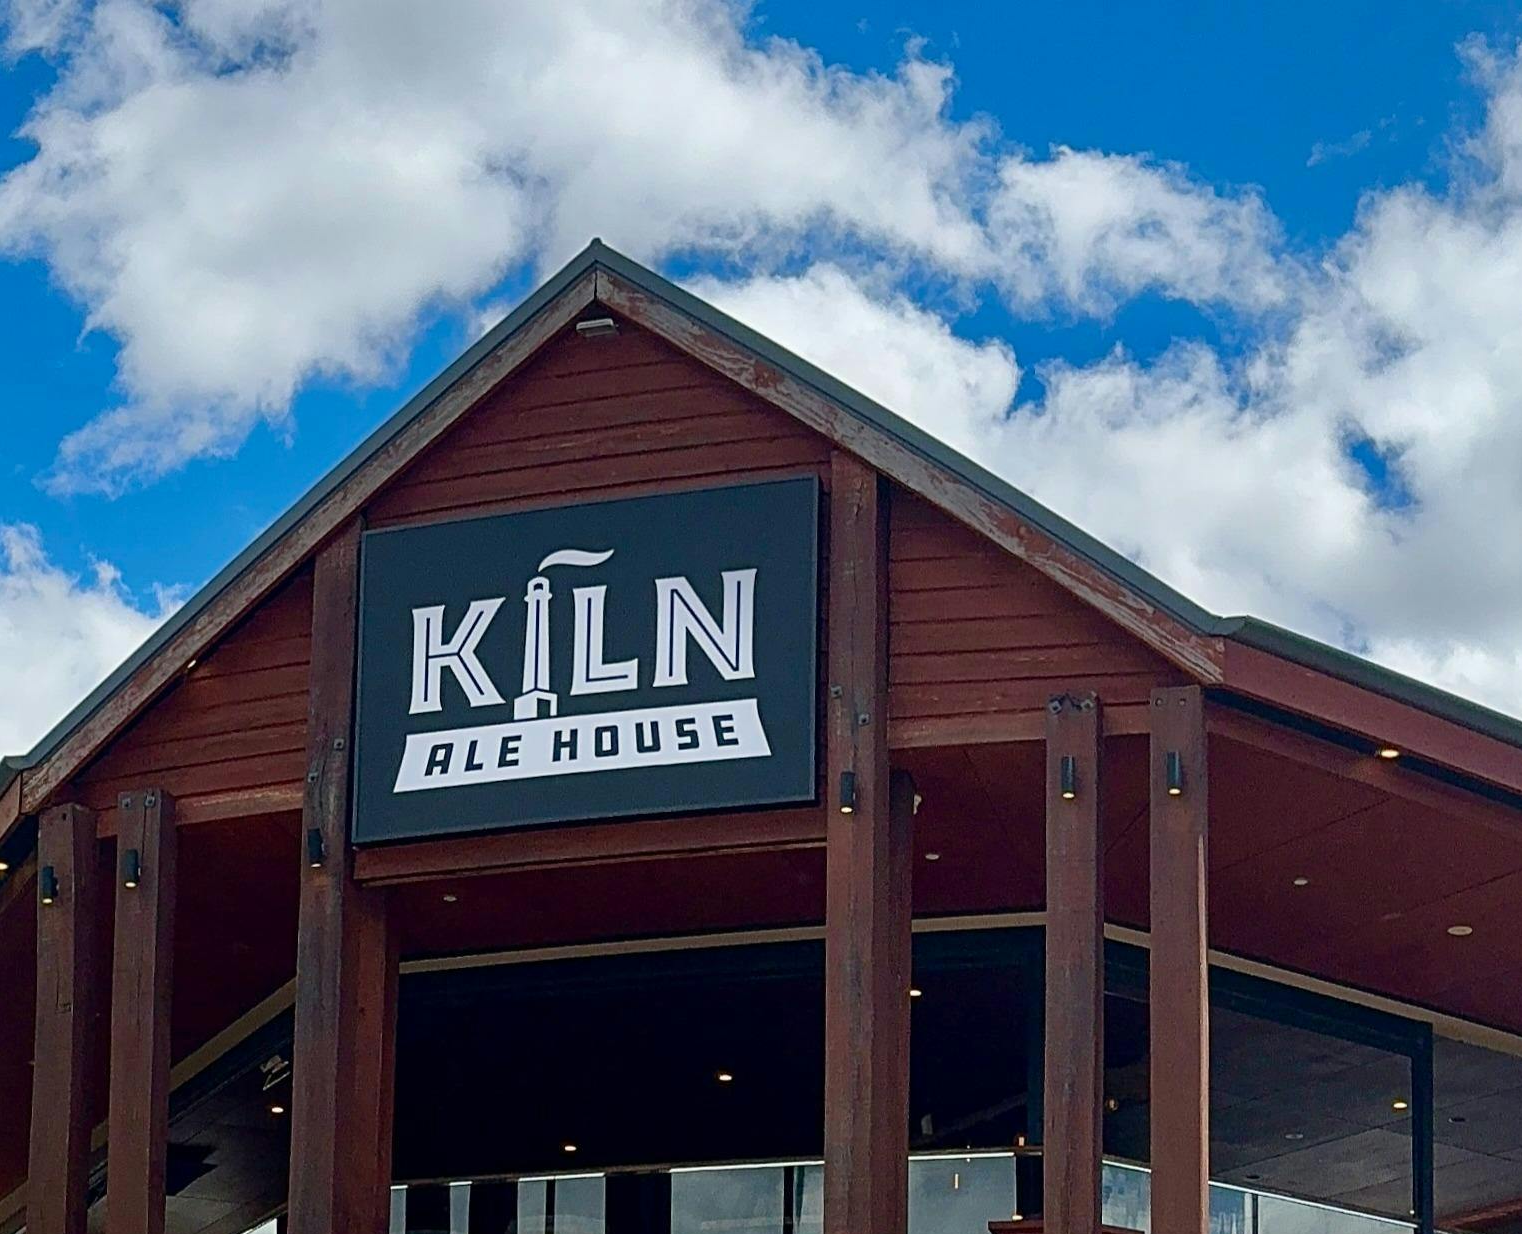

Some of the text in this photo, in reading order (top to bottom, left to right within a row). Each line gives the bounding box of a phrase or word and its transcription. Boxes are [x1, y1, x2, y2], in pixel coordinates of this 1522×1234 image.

[409, 569, 758, 720] KILN
[424, 713, 741, 777] ALE HOUSE
